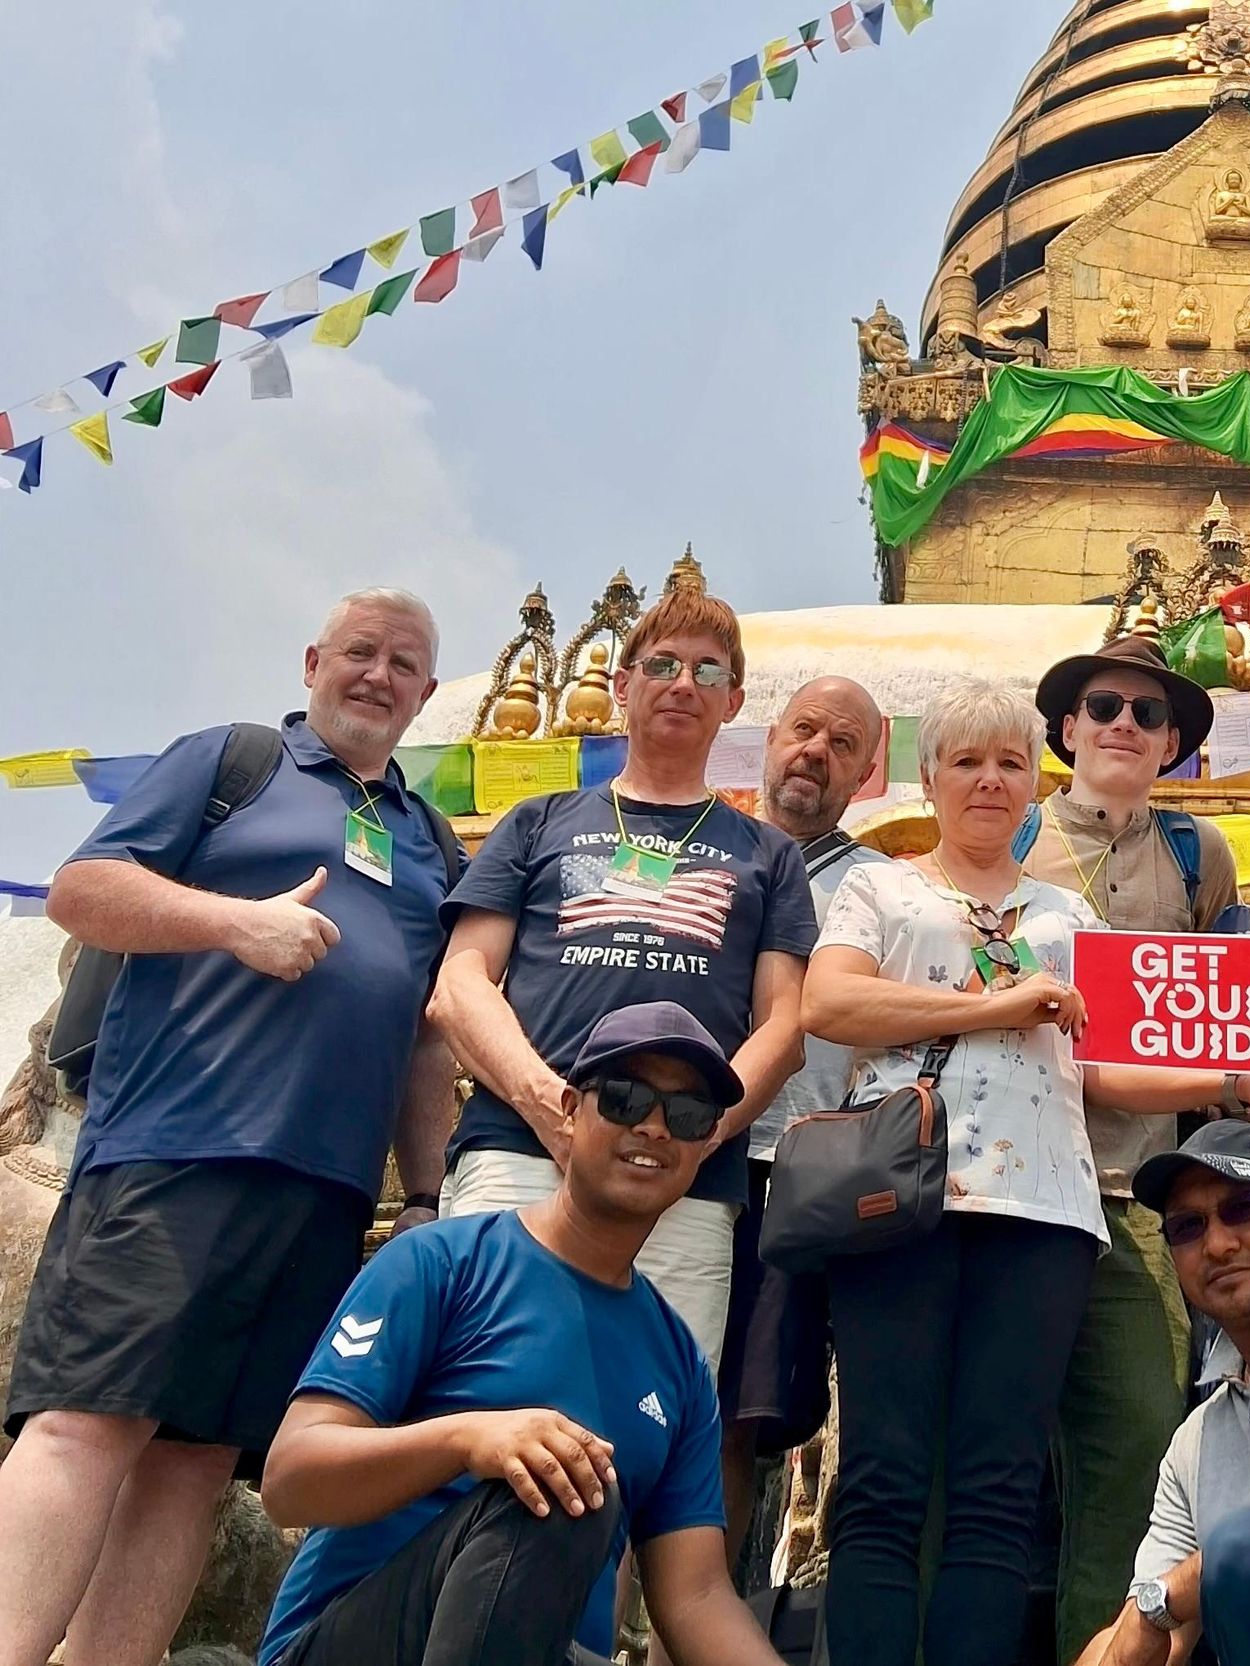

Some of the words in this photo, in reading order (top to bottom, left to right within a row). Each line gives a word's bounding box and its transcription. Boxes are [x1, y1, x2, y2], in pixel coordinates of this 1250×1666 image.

[572, 832, 621, 847] NEW
[628, 833, 682, 854] YORK
[687, 842, 733, 863] CITY
[612, 932, 641, 944] SINCE
[560, 946, 641, 968] EMPIRE
[645, 952, 709, 976] STATE
[1131, 942, 1228, 981] GET
